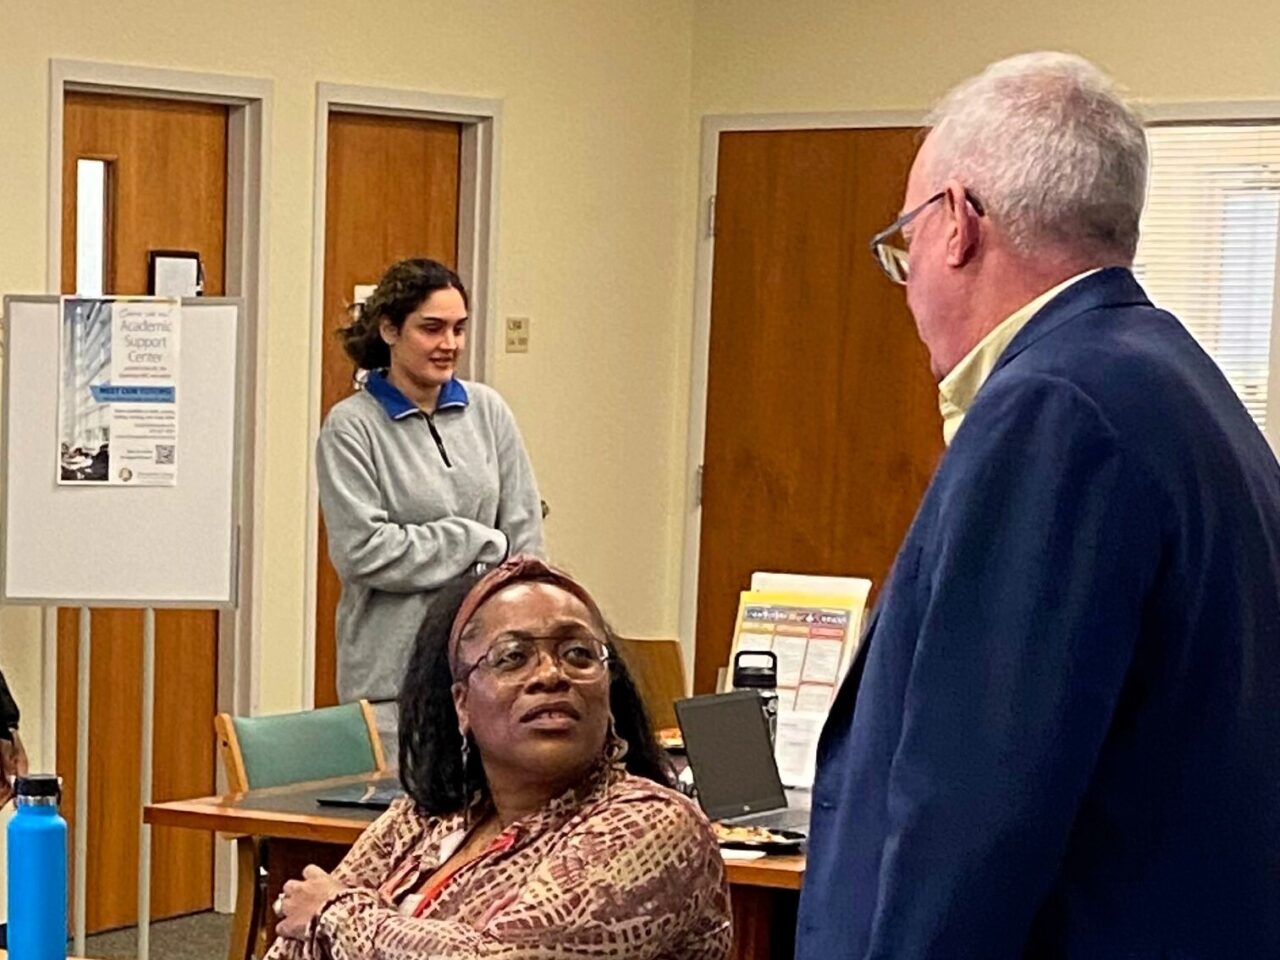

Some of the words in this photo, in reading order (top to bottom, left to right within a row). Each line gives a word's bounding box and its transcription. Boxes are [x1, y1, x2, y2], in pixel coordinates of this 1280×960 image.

[120, 320, 173, 332] Academic
[124, 335, 167, 350] Support
[128, 350, 163, 363] Center
